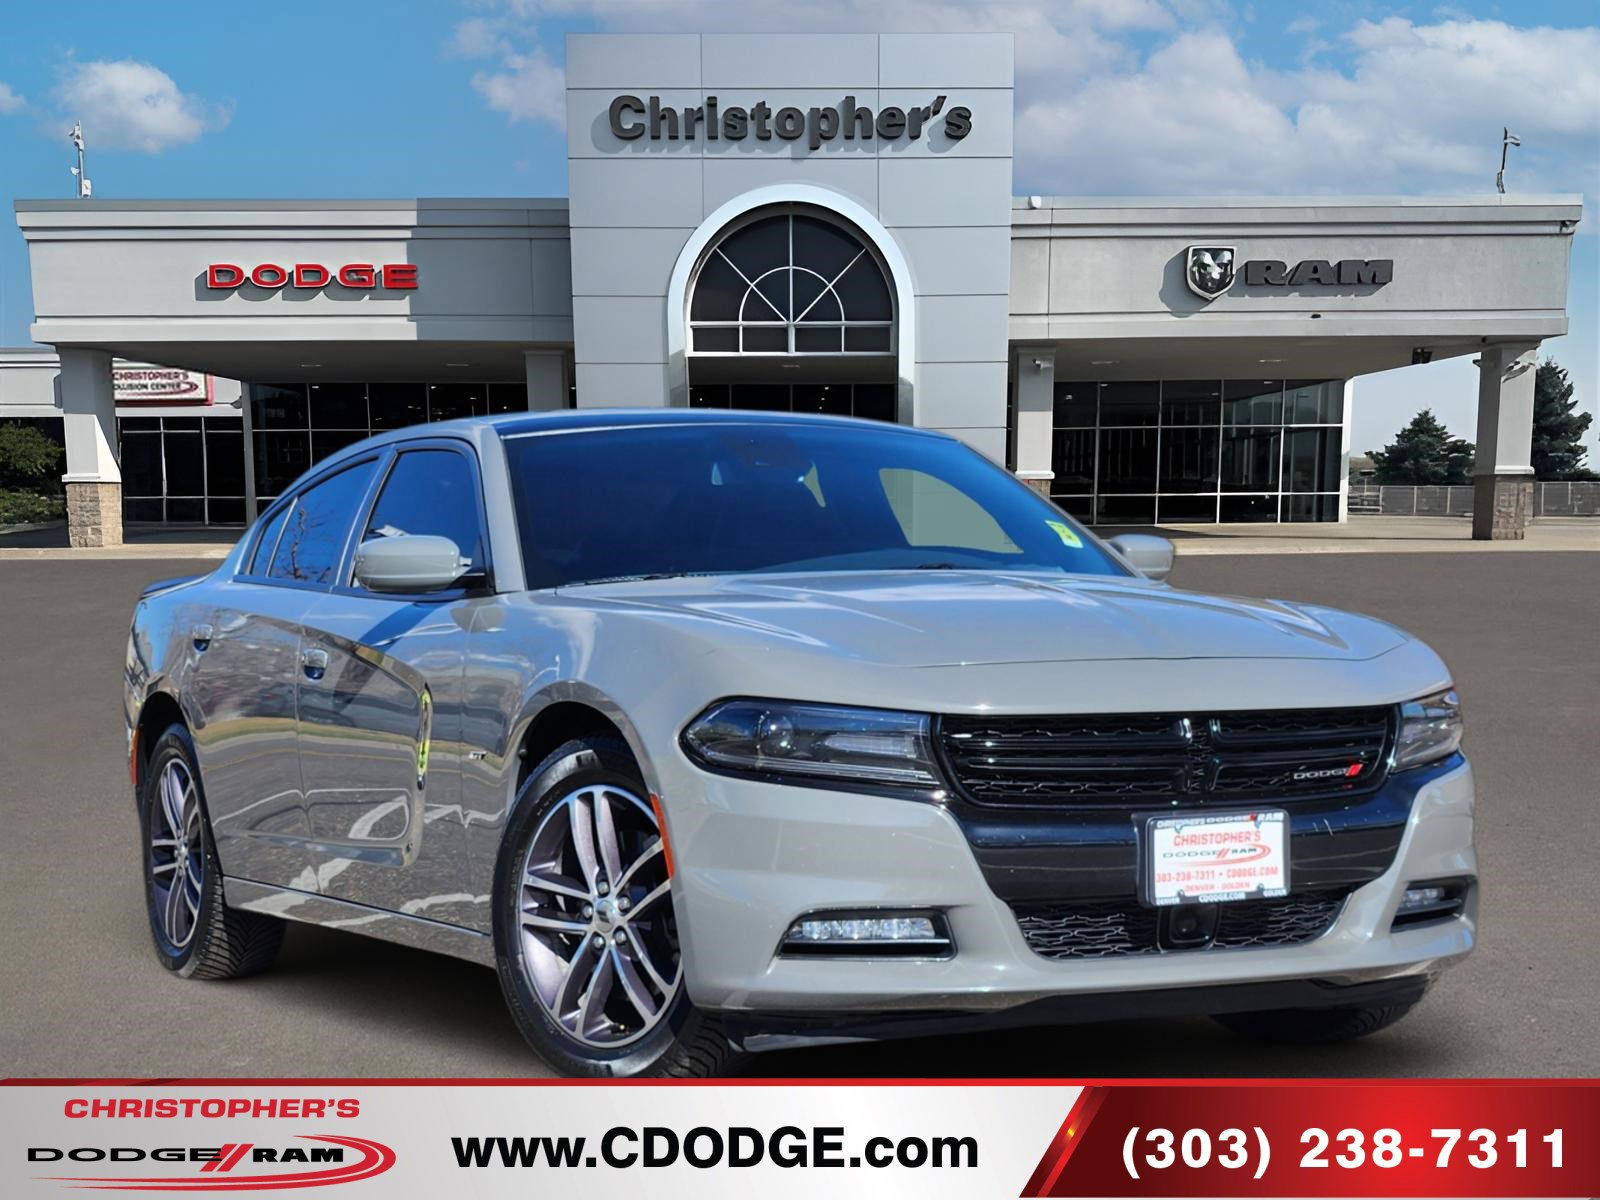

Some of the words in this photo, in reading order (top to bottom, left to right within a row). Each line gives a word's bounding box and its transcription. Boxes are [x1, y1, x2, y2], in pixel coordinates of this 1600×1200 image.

[608, 95, 972, 150] Christopher's
[206, 263, 418, 290] DODGE
[1244, 259, 1393, 287] RAM
[1173, 830, 1262, 847] CHRISTOPHER'S
[1231, 847, 1258, 855] RAM
